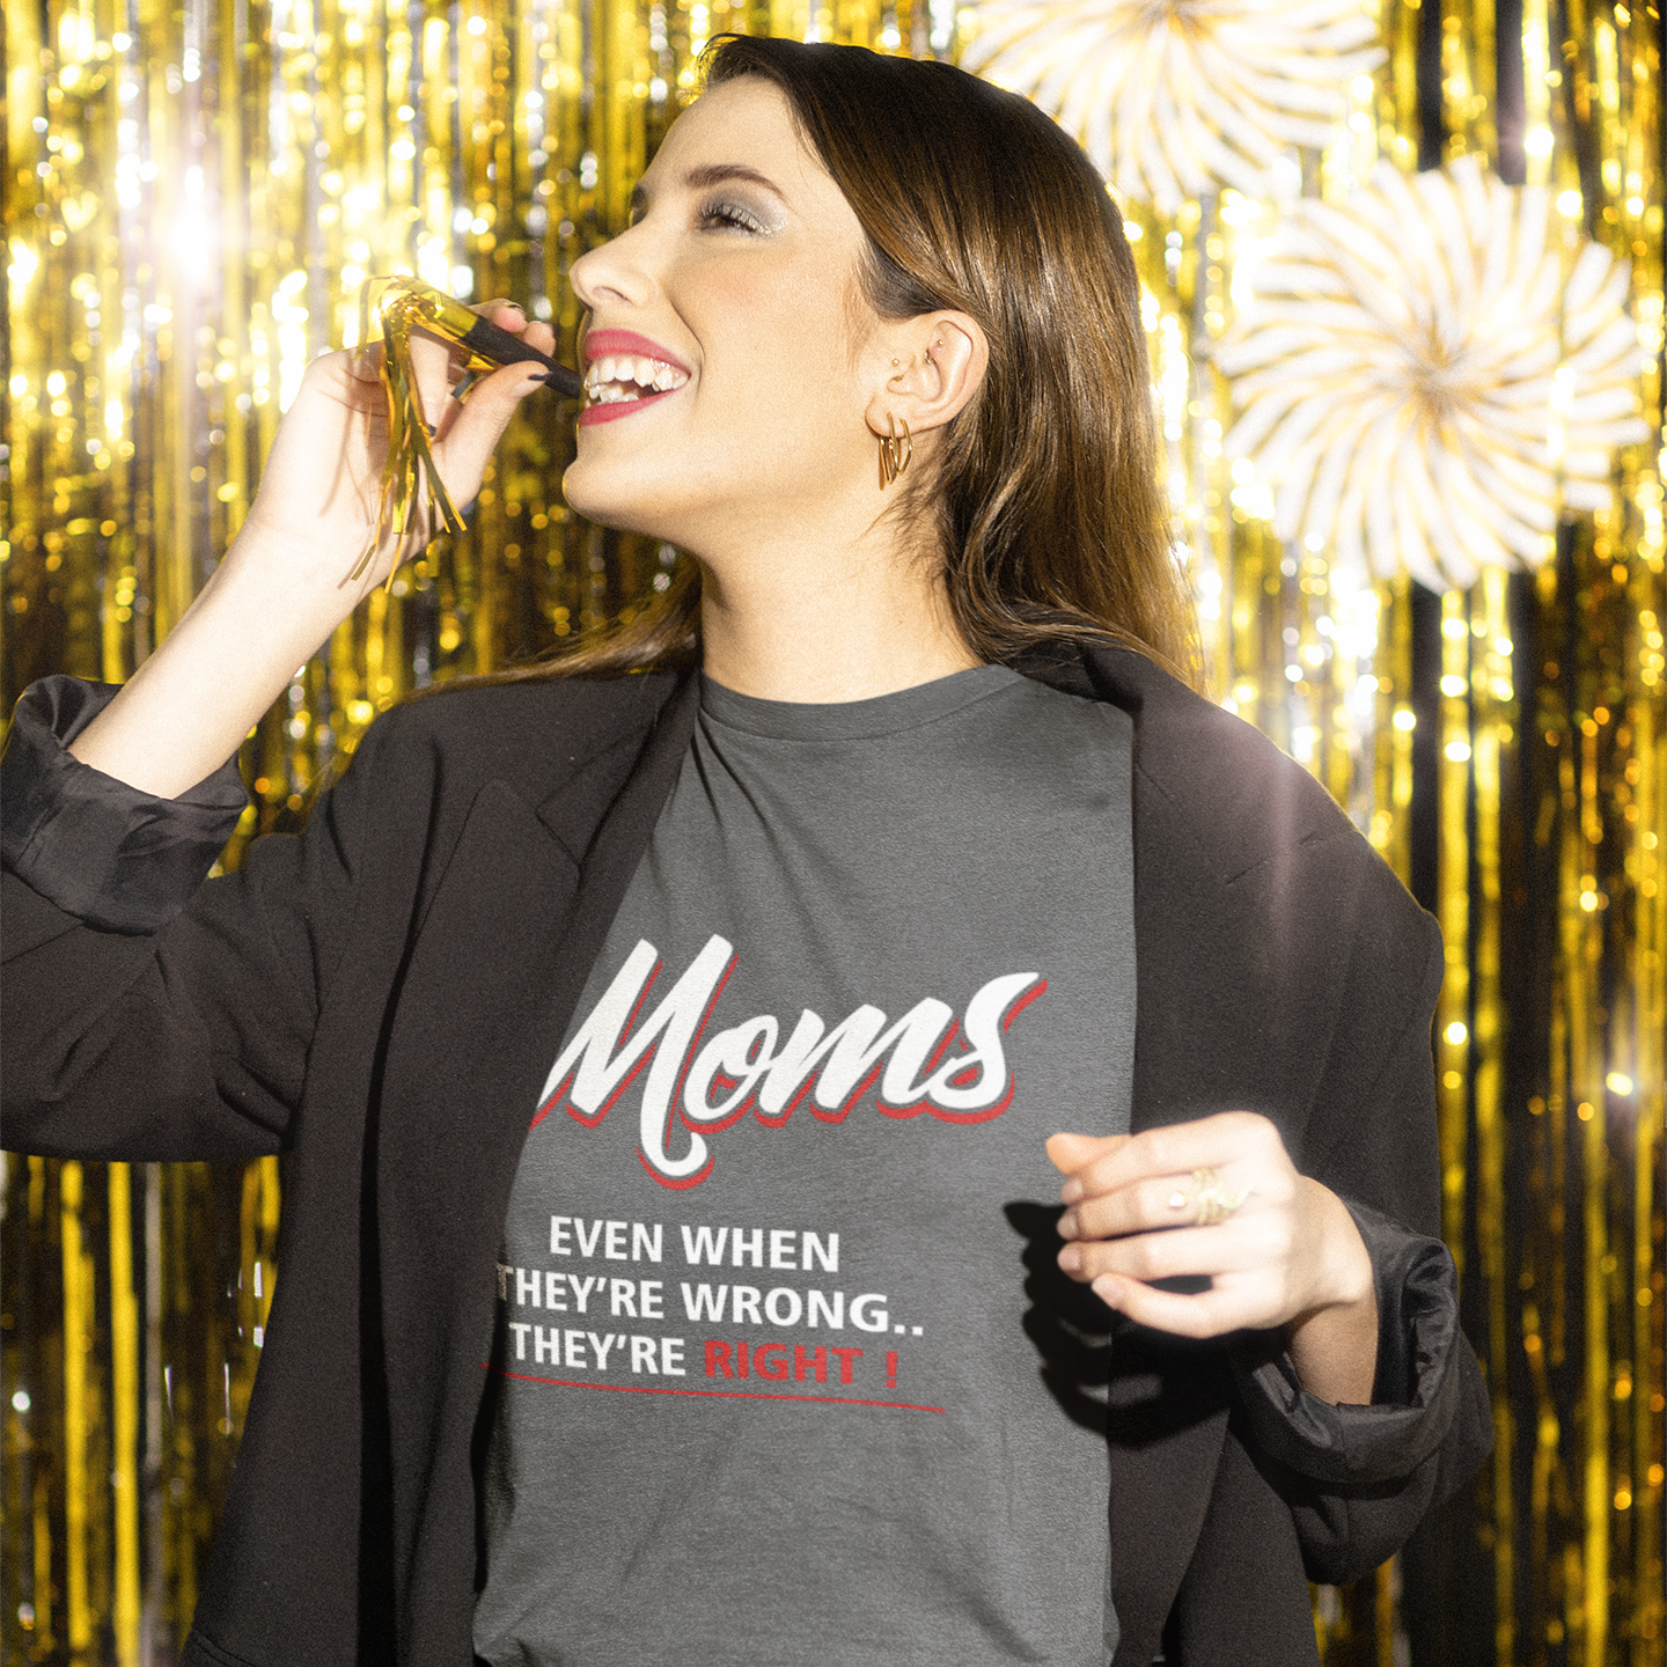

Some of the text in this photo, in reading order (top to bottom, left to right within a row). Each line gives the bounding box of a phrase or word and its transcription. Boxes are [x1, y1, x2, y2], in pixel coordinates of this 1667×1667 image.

[529, 933, 1048, 1189] Moms
[550, 1215, 839, 1272] EVEN WHEN
[497, 1262, 924, 1336] THEY'RE WRONG..
[508, 1321, 686, 1376] THEY'RE
[704, 1339, 863, 1385] RIGHT
